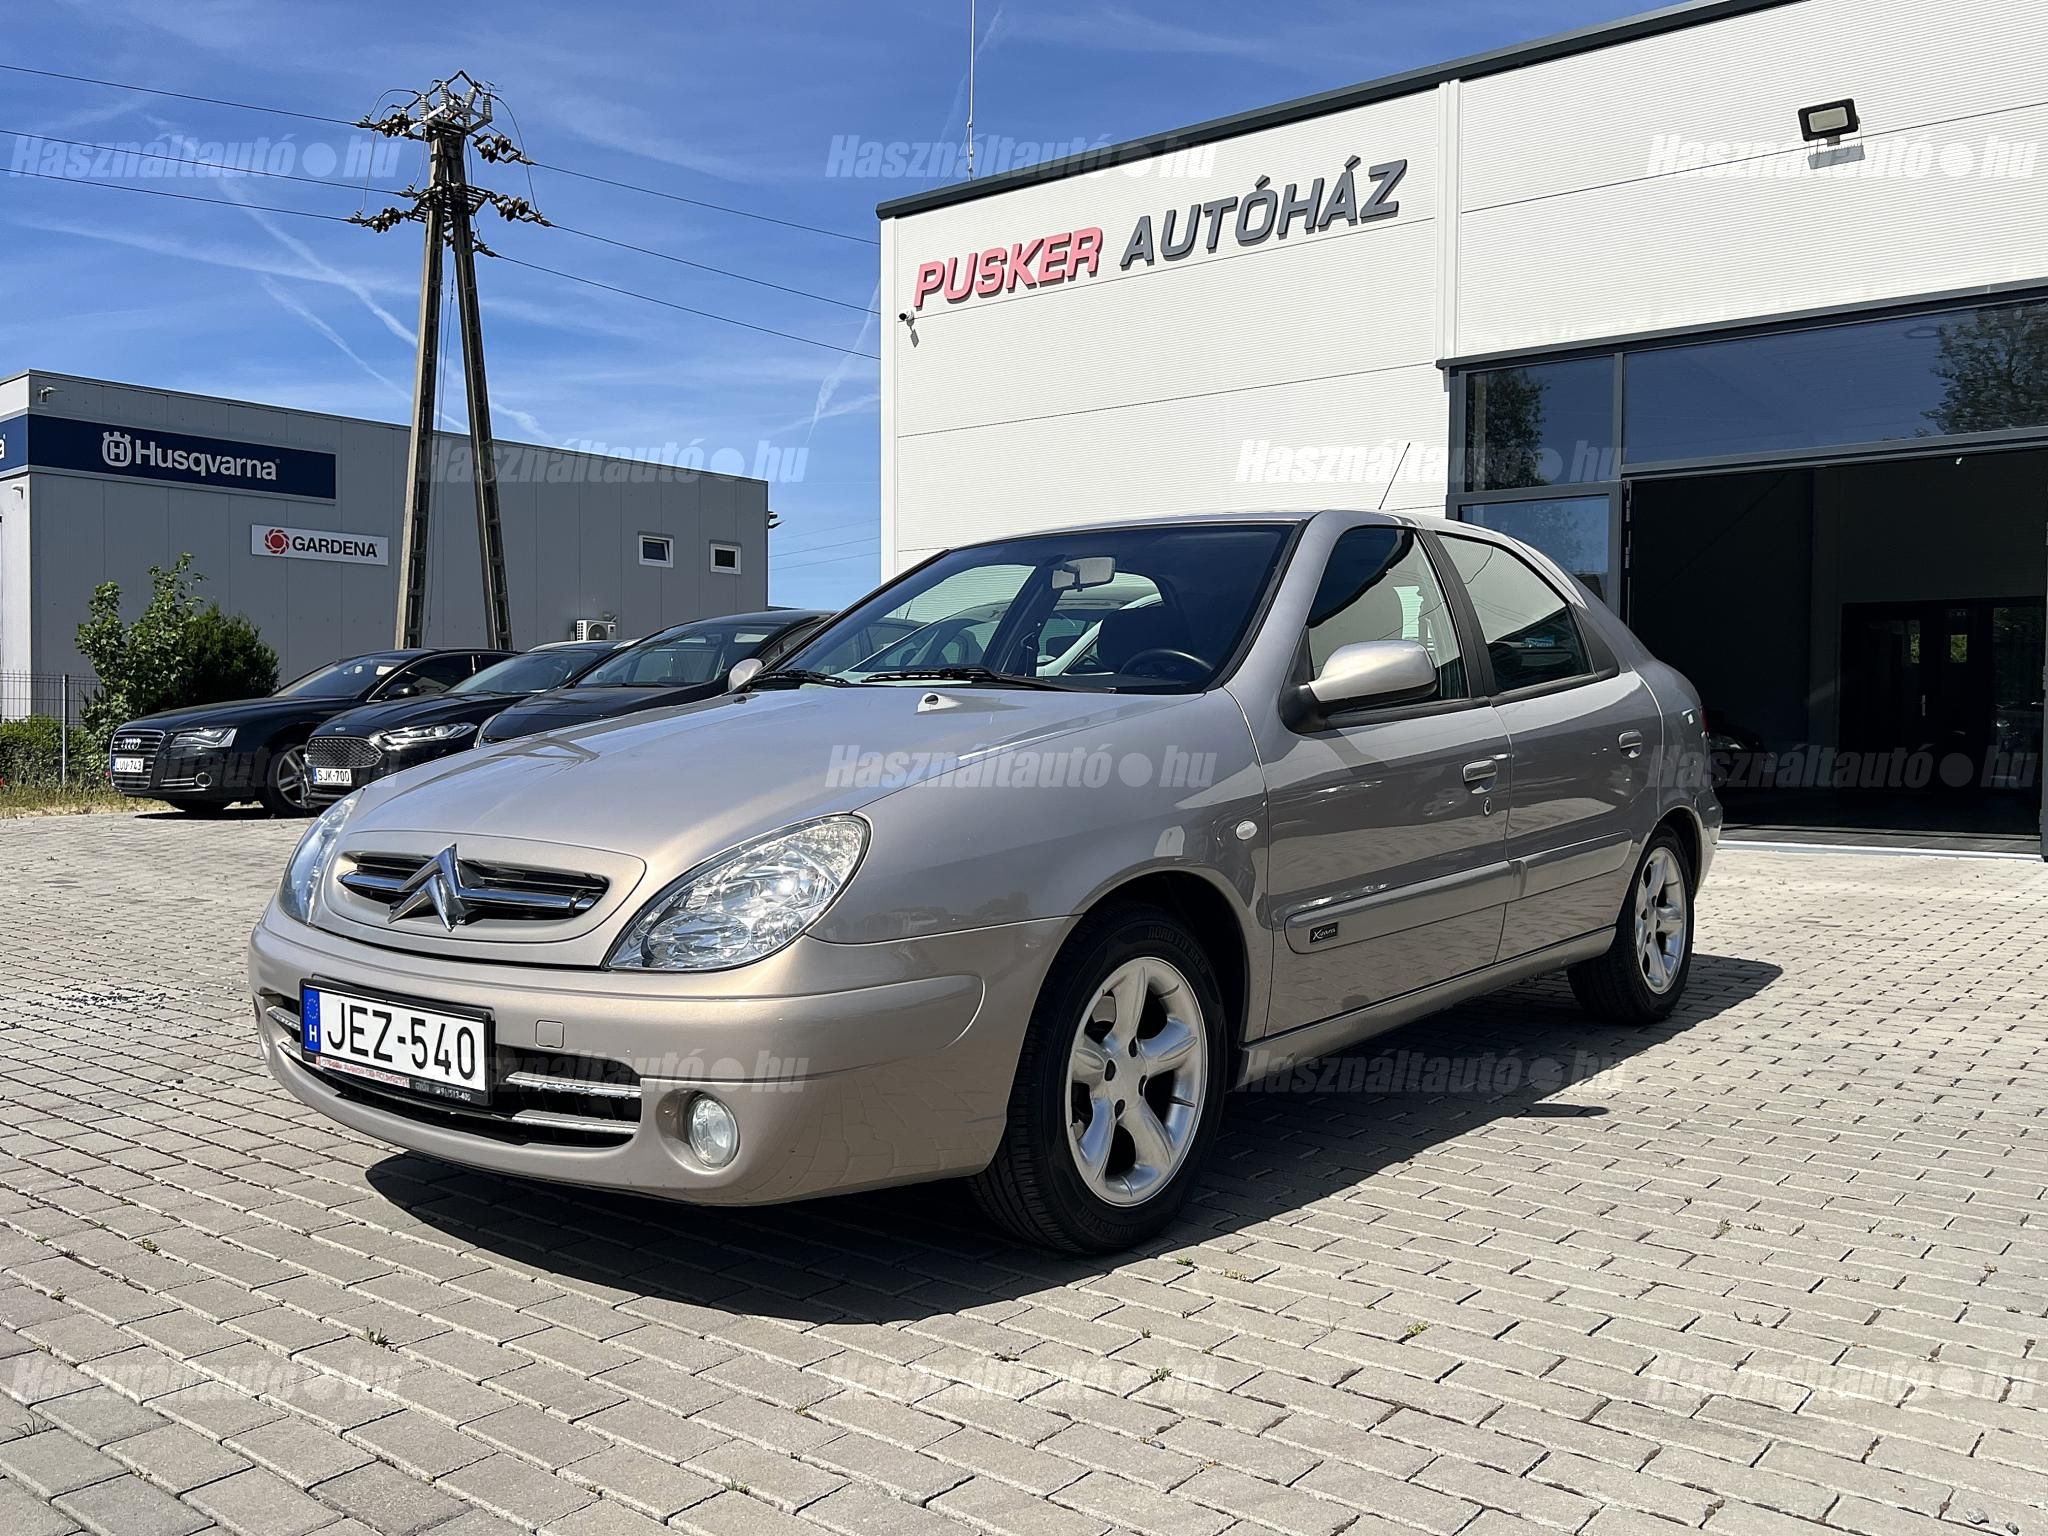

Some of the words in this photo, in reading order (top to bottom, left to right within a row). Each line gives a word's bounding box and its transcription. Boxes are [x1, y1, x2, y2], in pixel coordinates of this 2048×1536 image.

[913, 226, 1103, 308] PUSKER
[1120, 155, 1408, 270] AUTÓHÁZ
[135, 439, 277, 480] Husqvarna
[292, 536, 378, 558] GARDENA
[317, 769, 350, 782] SJK-700
[309, 1024, 318, 1043] H
[327, 1002, 476, 1080] JEZ-540
